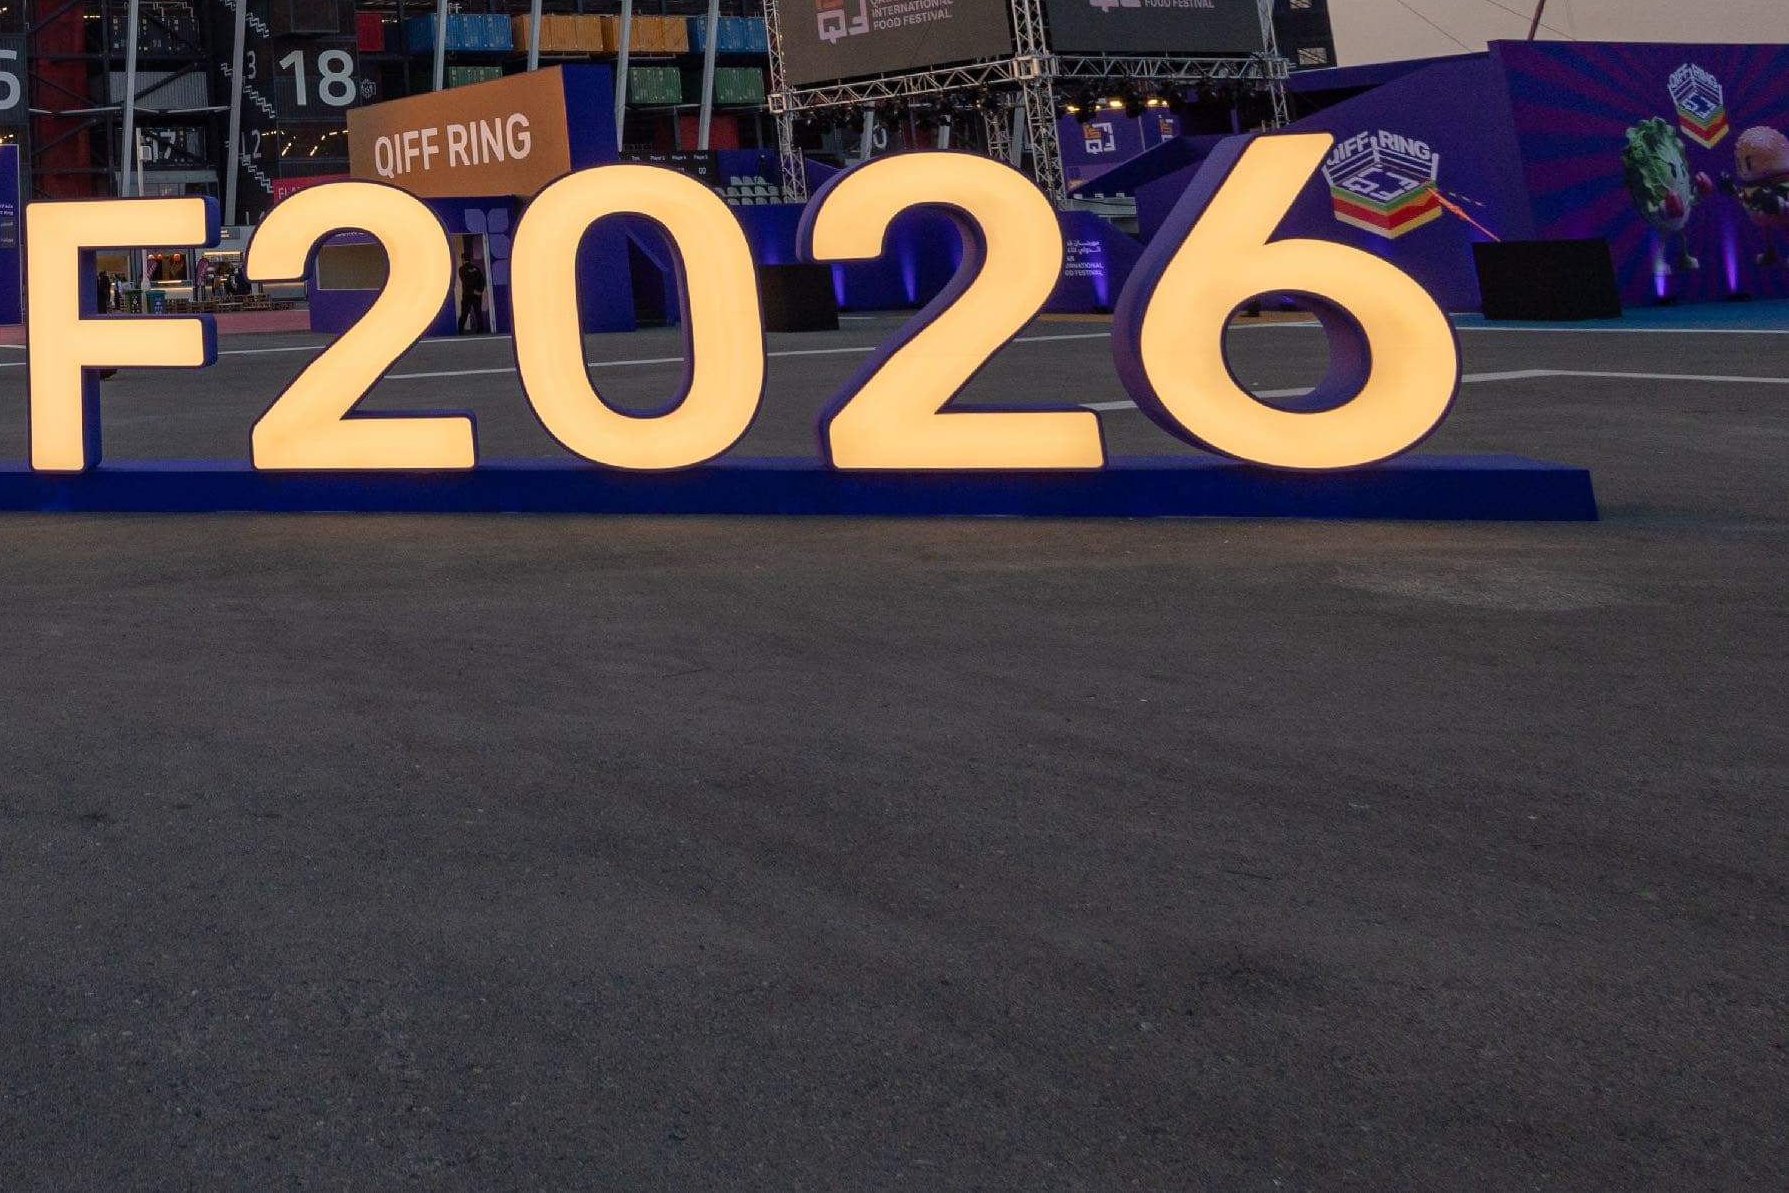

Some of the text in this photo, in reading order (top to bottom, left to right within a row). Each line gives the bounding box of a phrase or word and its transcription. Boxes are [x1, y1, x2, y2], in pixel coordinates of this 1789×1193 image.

[873, 8, 952, 31] FOOD FESTIVAL
[279, 50, 357, 106] 18
[375, 112, 531, 179] QIFF RING
[1378, 129, 1431, 160] RING
